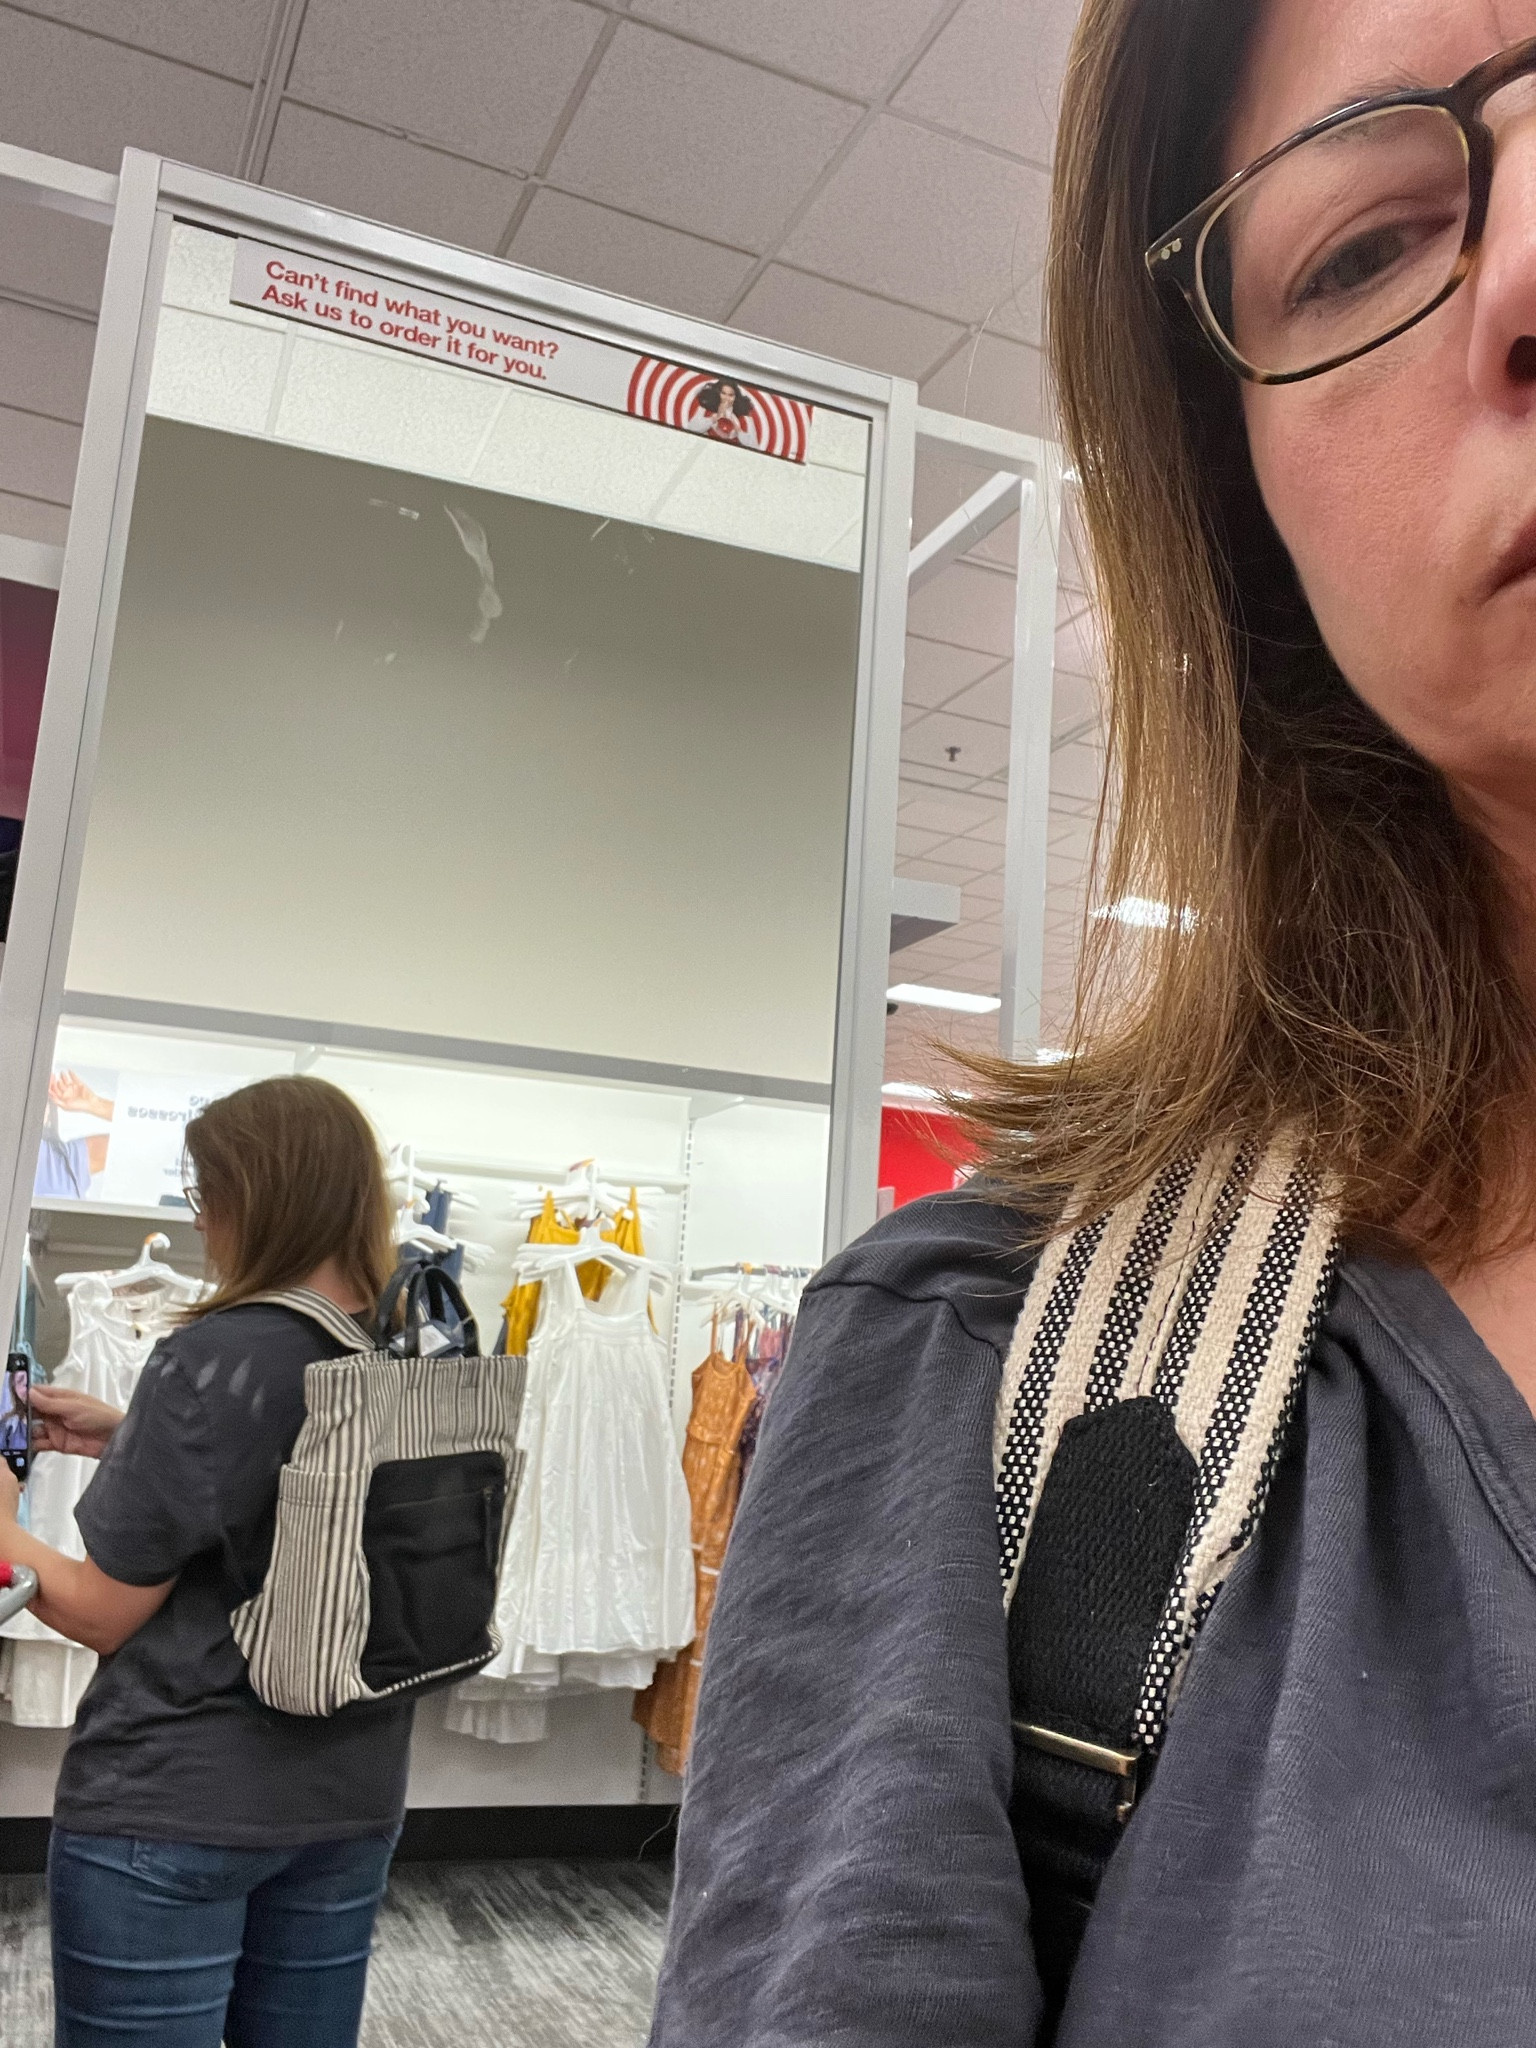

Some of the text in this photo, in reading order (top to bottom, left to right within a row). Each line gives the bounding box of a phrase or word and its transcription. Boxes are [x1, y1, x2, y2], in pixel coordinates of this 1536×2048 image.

[262, 284, 547, 380] Ask us to order it for you.
[265, 260, 559, 359] Can't find what you want?
